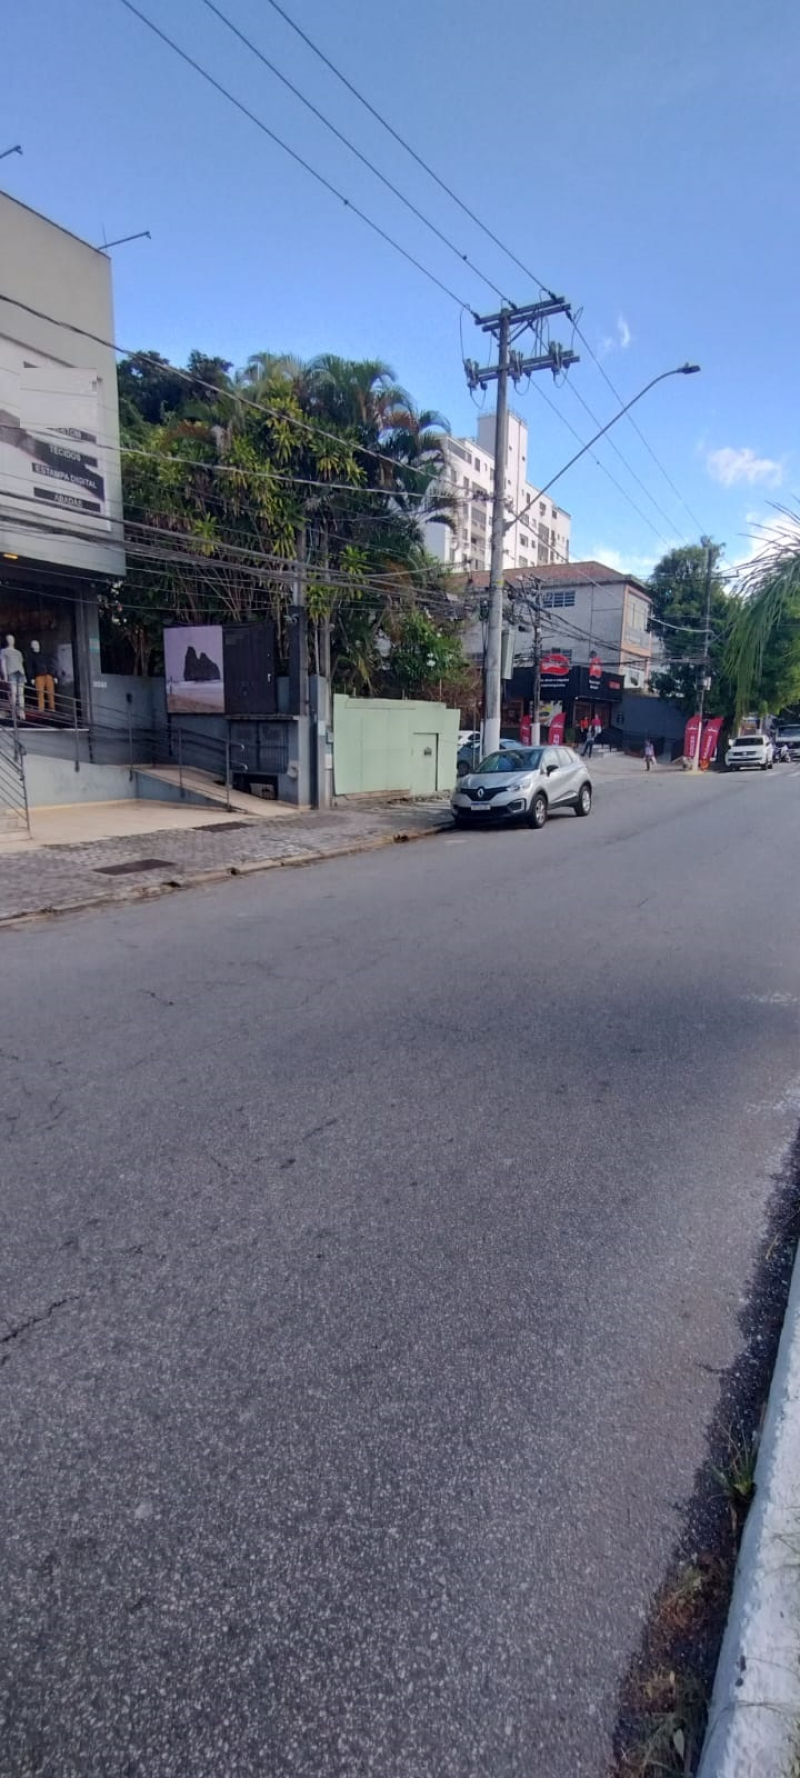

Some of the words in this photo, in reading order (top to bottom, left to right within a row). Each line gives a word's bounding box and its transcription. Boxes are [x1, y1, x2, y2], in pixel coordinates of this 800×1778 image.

[49, 445, 81, 462] TECIDOS
[35, 464, 69, 481] ESTAMPA
[71, 474, 98, 489] DIGITAL
